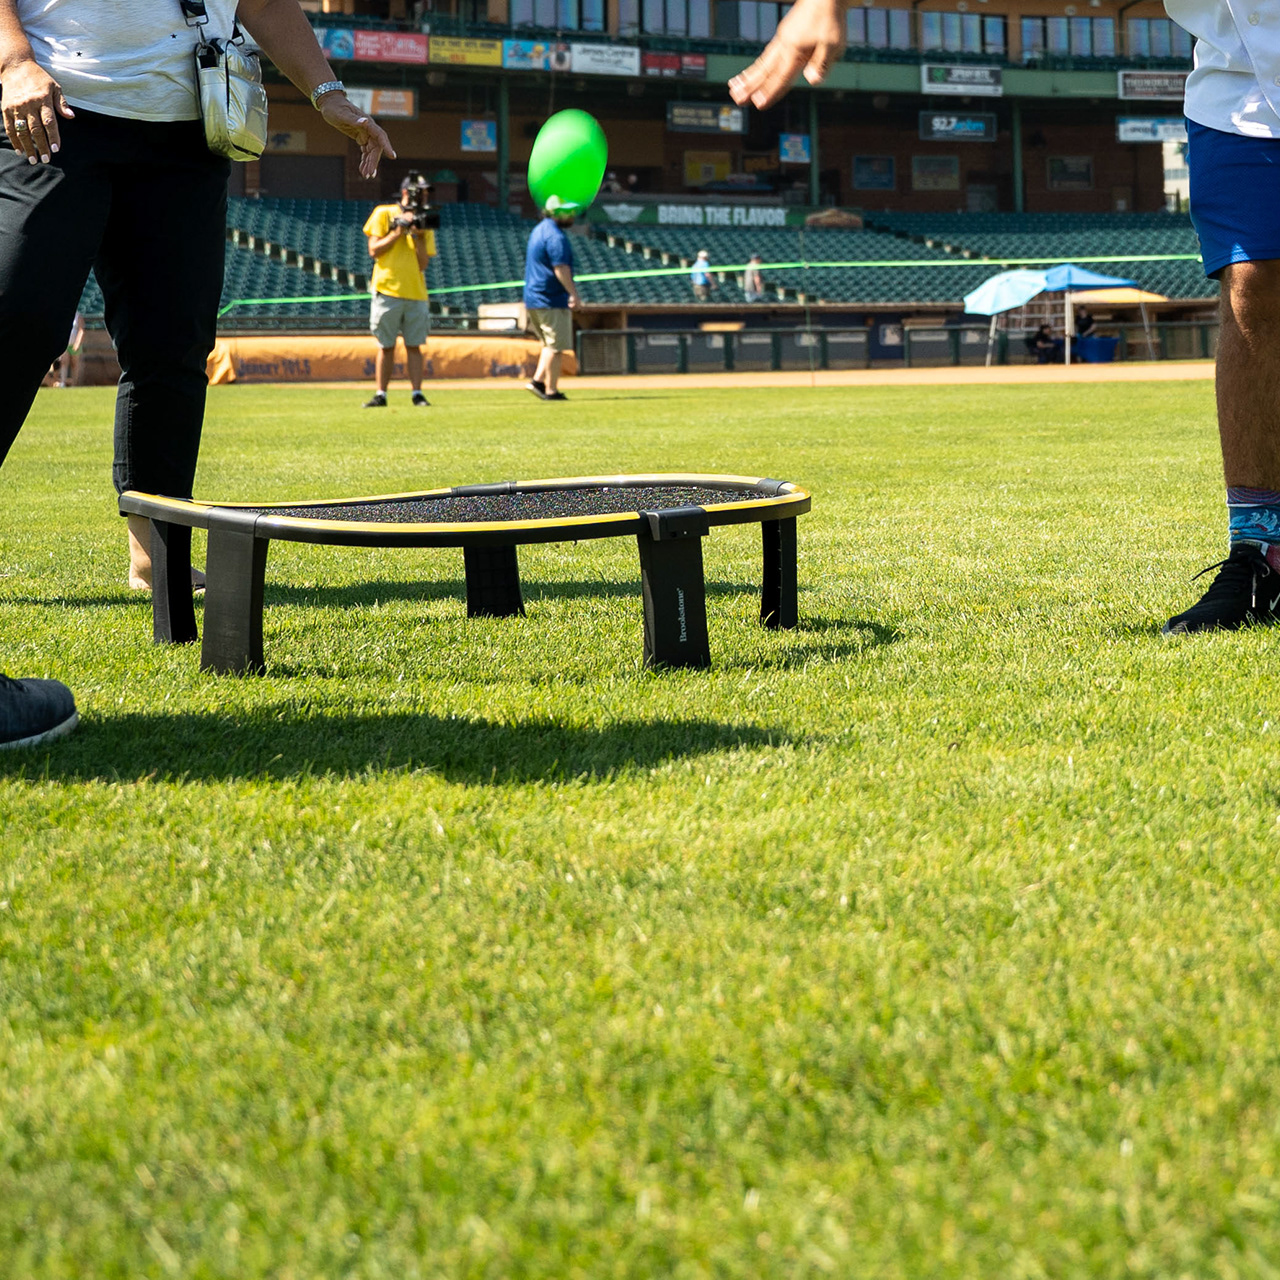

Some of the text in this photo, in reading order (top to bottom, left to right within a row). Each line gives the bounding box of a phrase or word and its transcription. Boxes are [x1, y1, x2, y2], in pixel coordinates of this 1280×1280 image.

[657, 205, 786, 226] BRING THE FLAVOR
